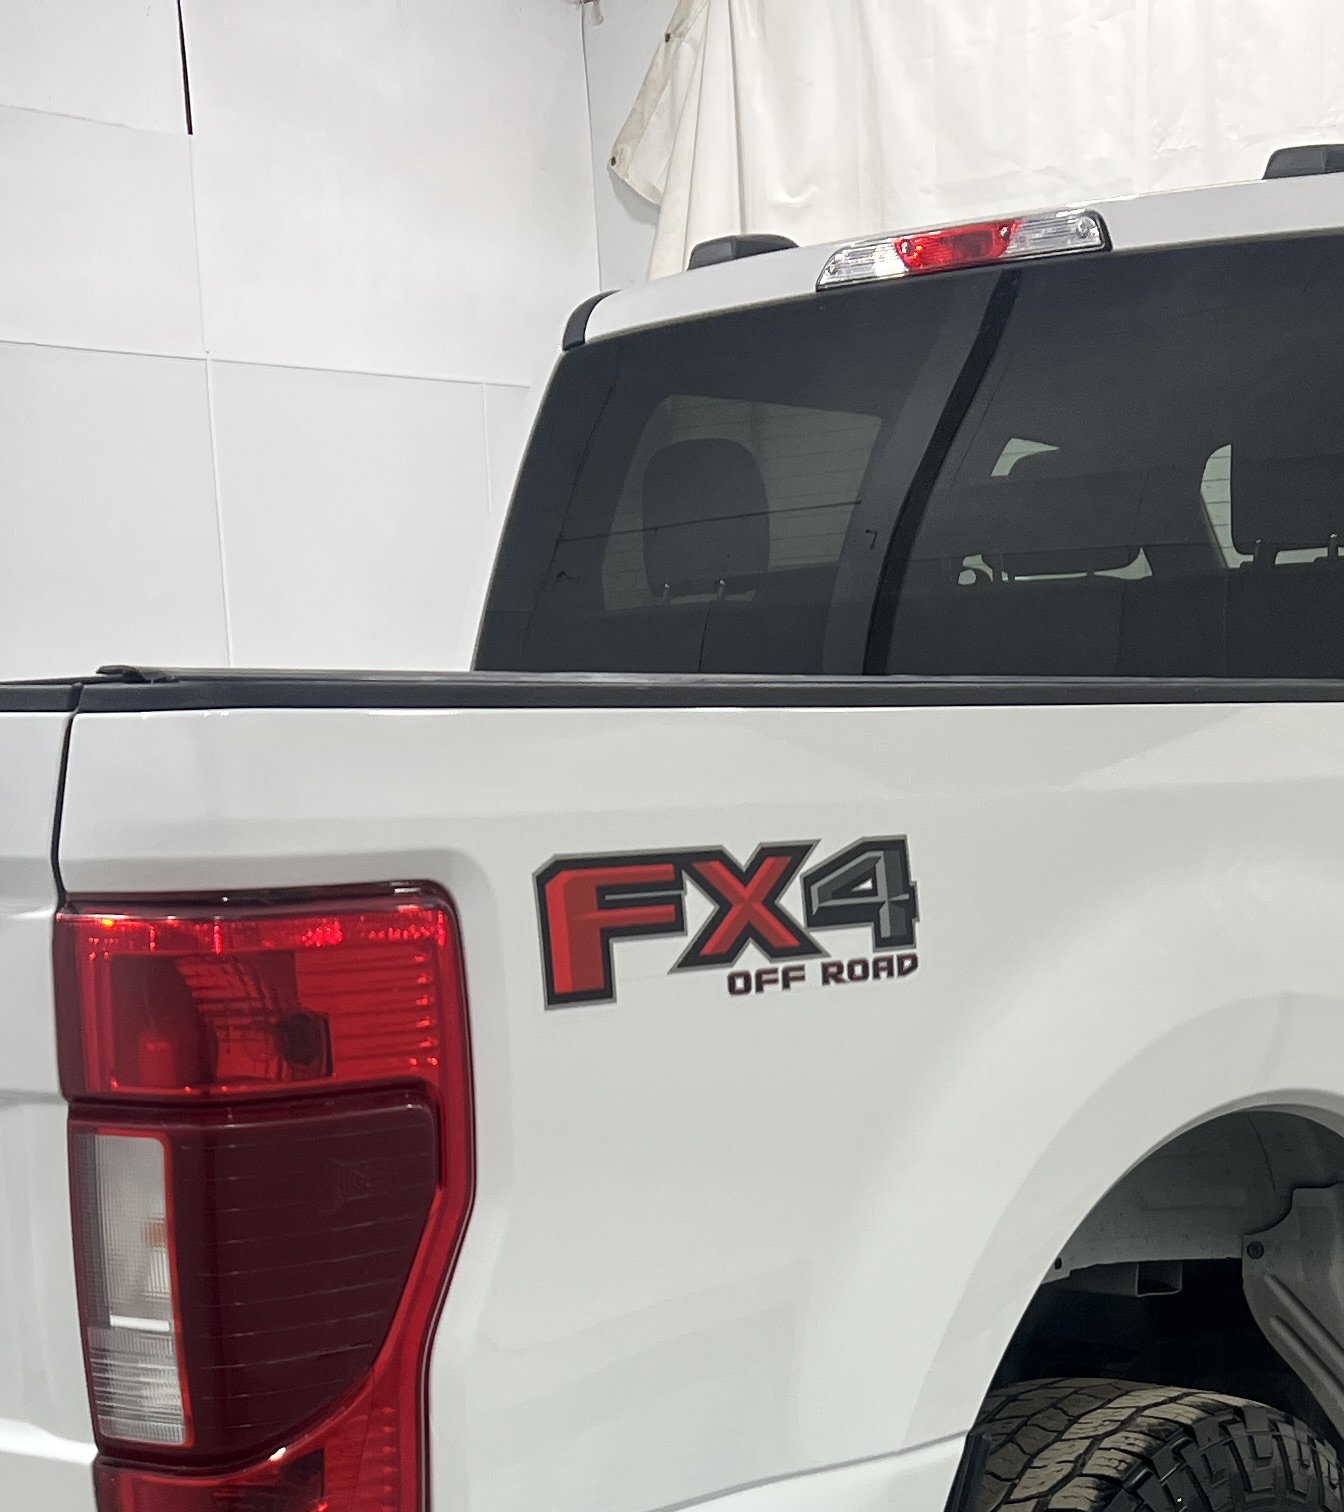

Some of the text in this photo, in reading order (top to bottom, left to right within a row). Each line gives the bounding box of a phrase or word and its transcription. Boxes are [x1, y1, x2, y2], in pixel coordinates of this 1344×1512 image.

[532, 834, 920, 1011] FX4
[727, 953, 919, 996] OFF ROAD
